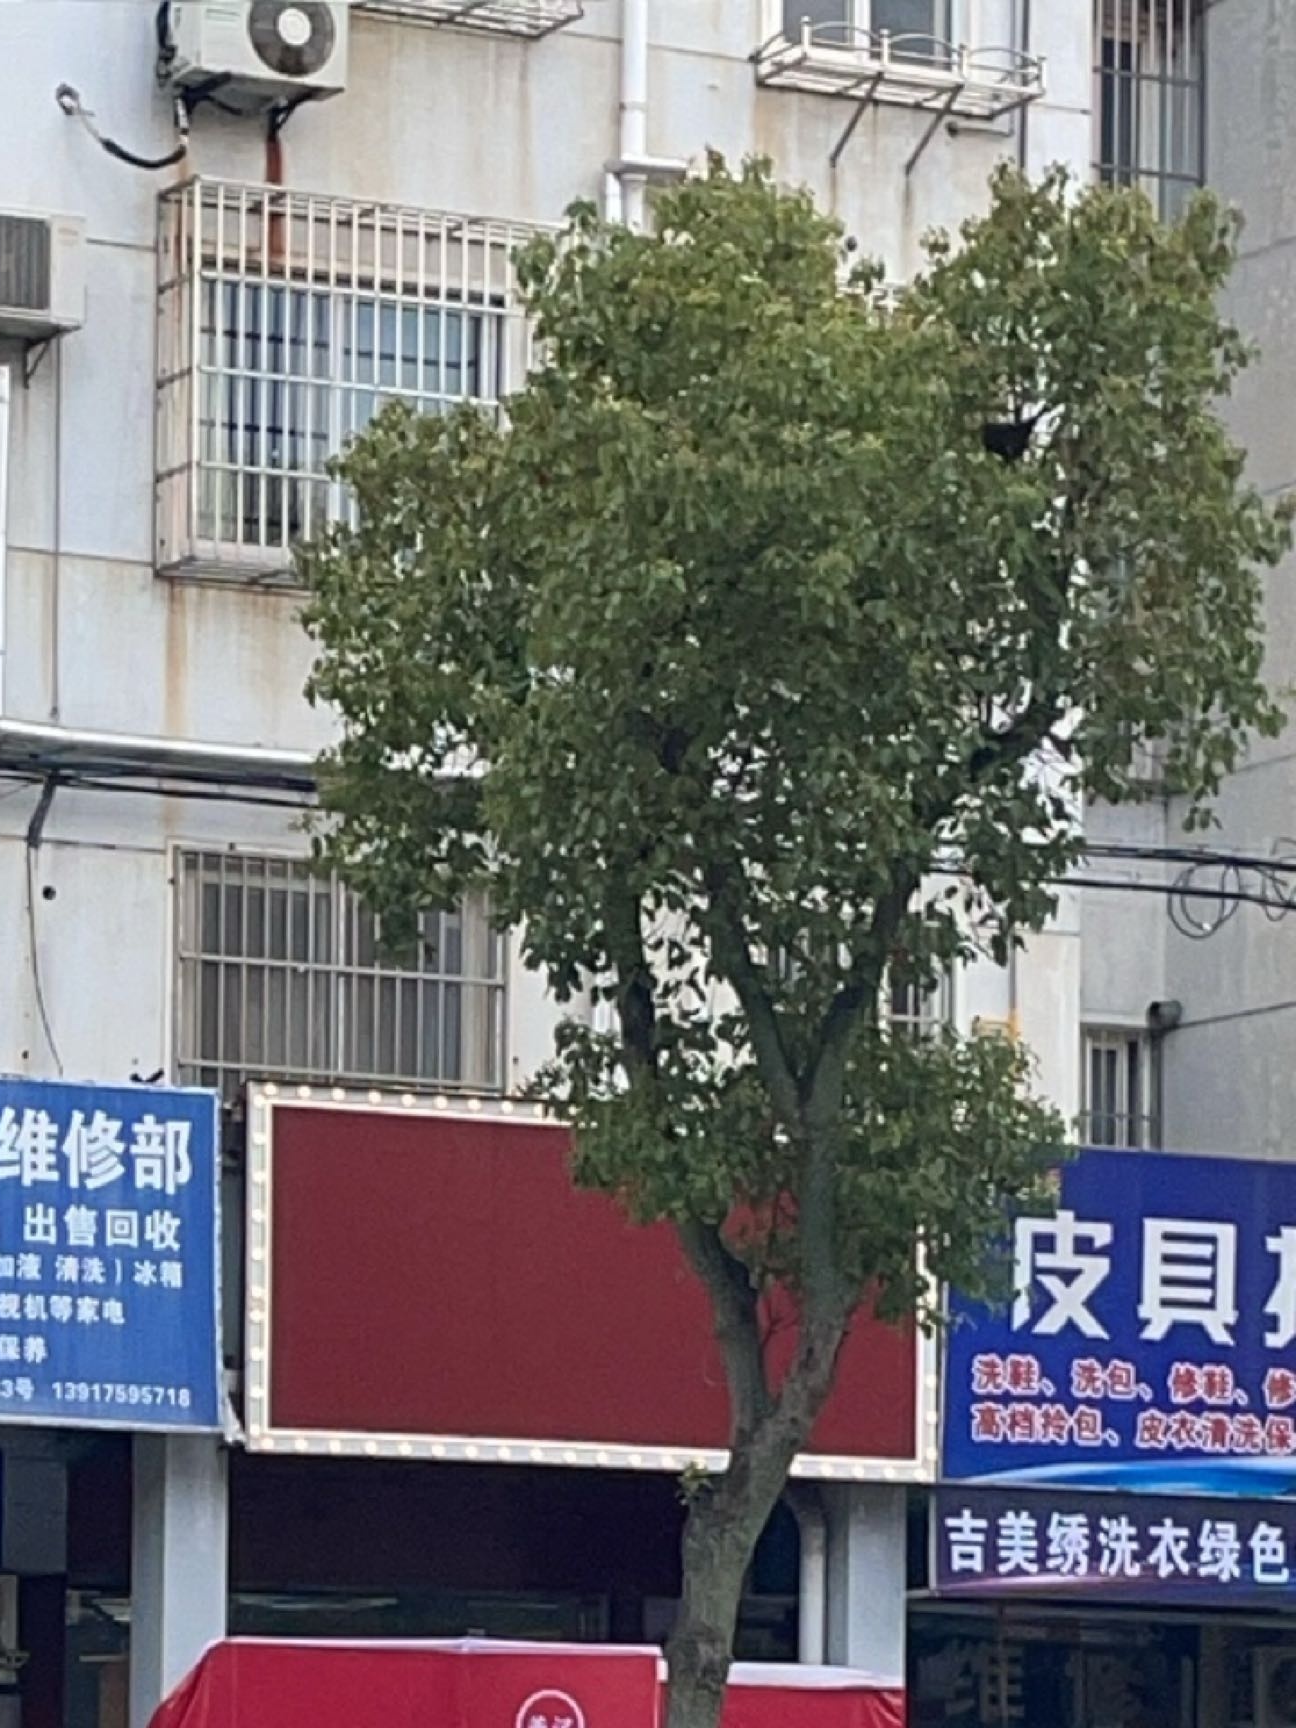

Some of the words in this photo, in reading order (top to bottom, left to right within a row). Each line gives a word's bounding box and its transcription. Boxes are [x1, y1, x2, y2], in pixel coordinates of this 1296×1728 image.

[24, 1203, 182, 1252] 出售回收
[945, 1508, 1289, 1583] 吉美绣洗衣绿色
